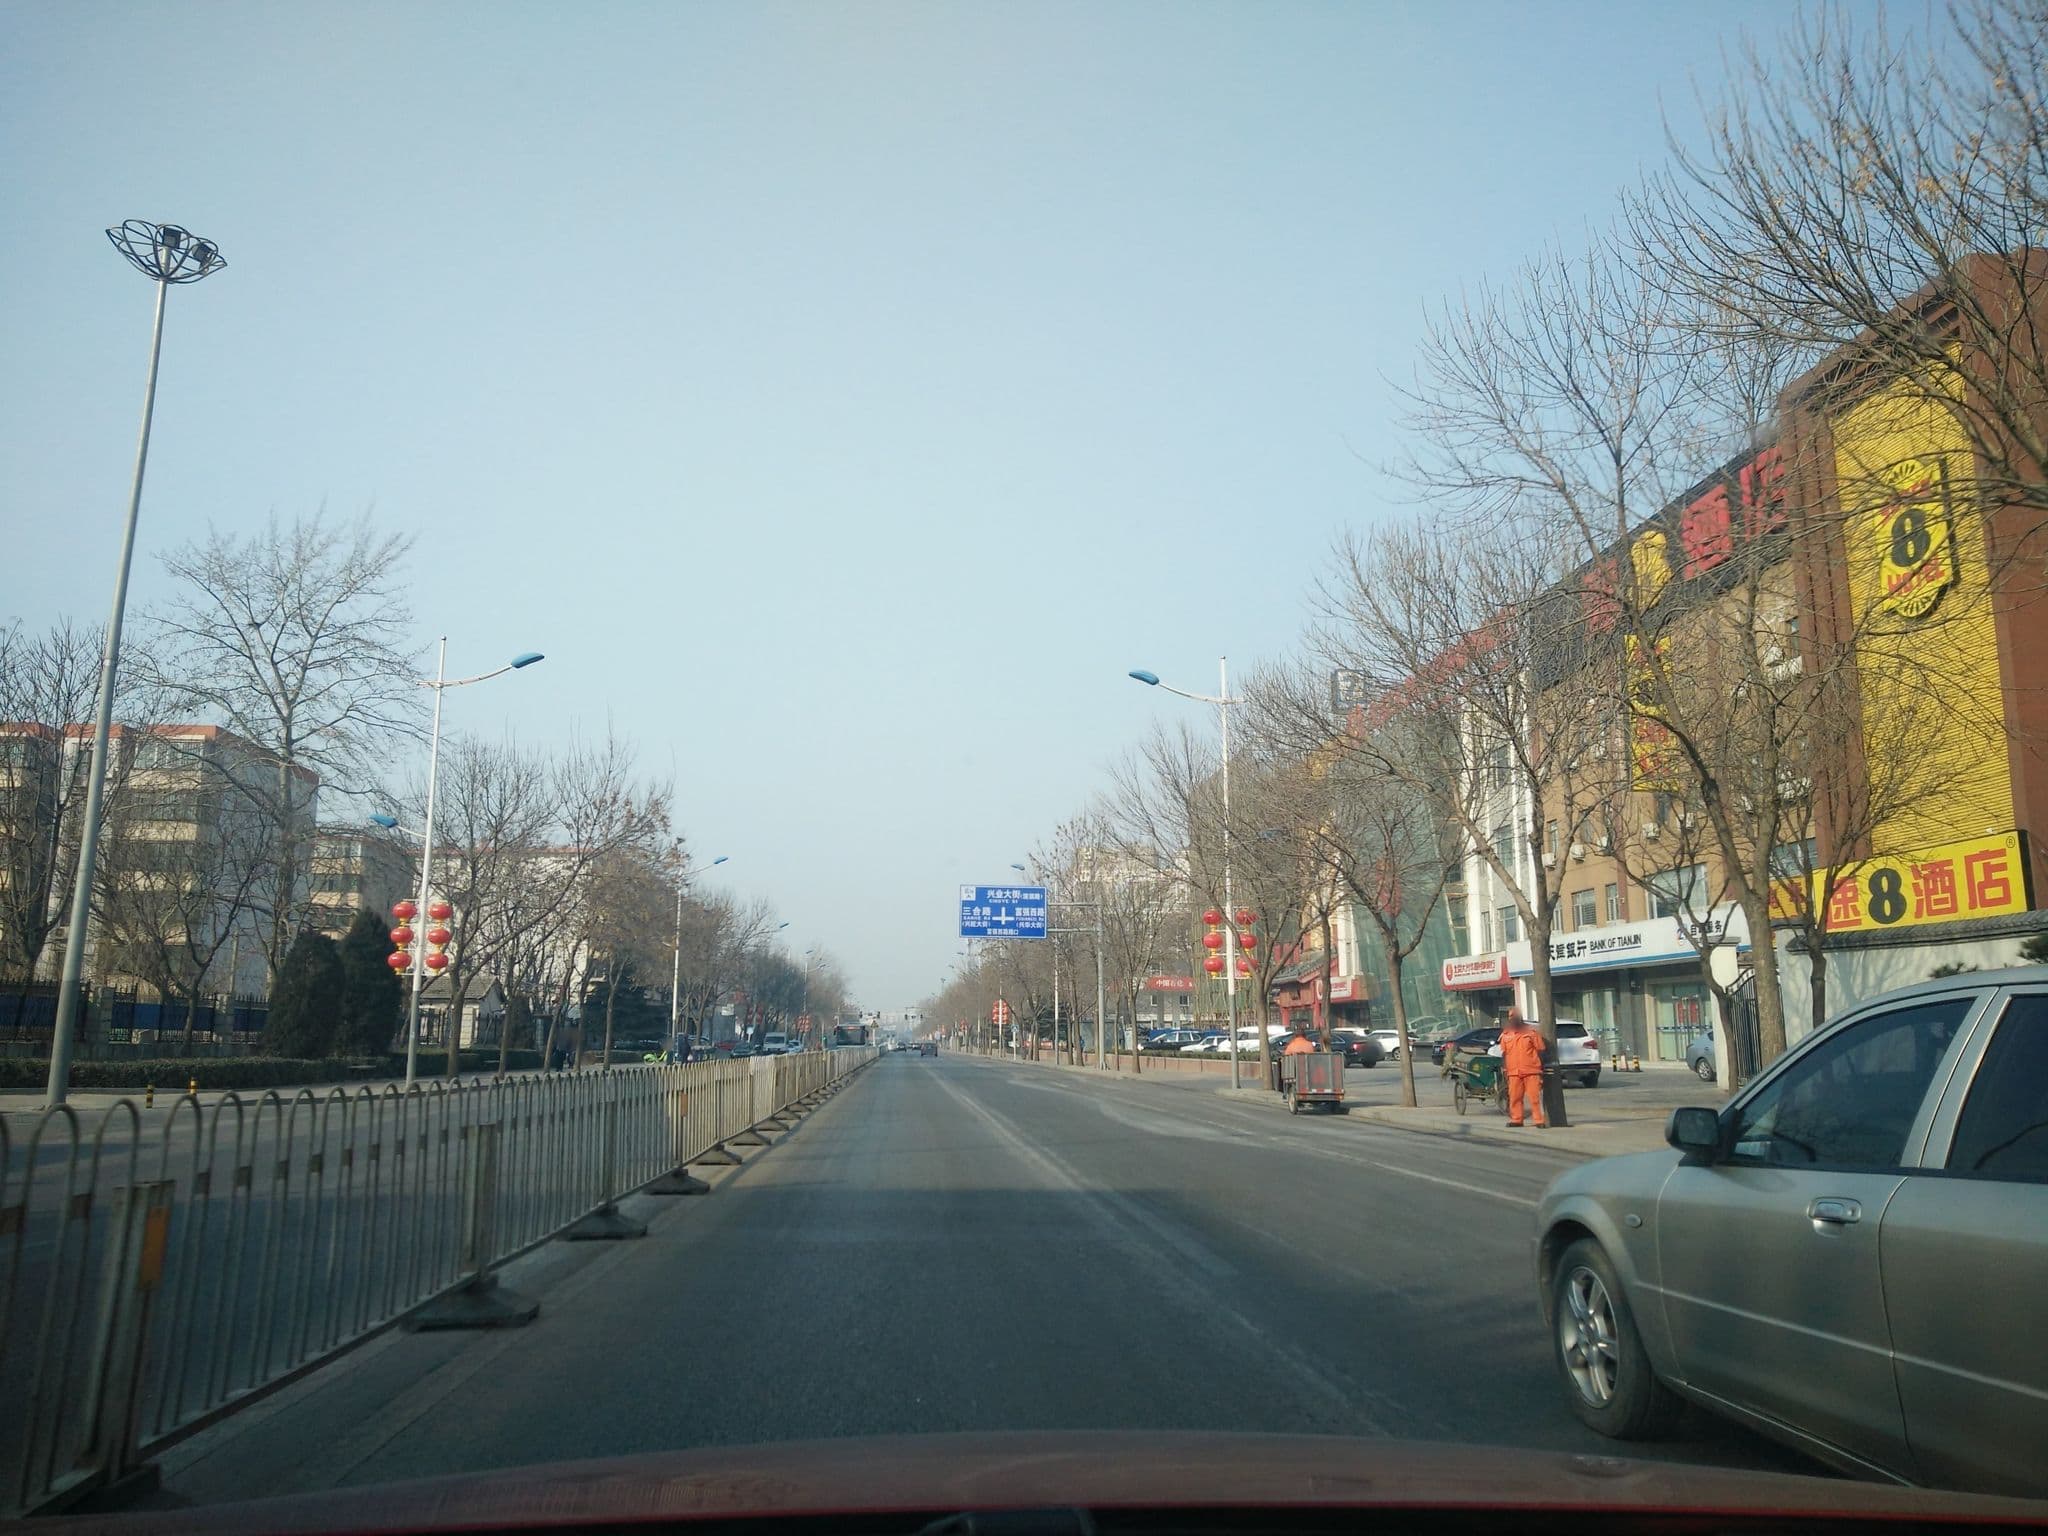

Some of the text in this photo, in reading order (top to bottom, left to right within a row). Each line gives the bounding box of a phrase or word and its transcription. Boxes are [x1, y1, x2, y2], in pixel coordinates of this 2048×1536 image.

[1891, 508, 1931, 568] 8
[1824, 847, 2012, 931] 速8酒店
[963, 906, 991, 915] 三合路
[1589, 938, 1607, 951] BANK
[1607, 937, 1616, 948] OF
[1617, 933, 1642, 947] TIANJIN
